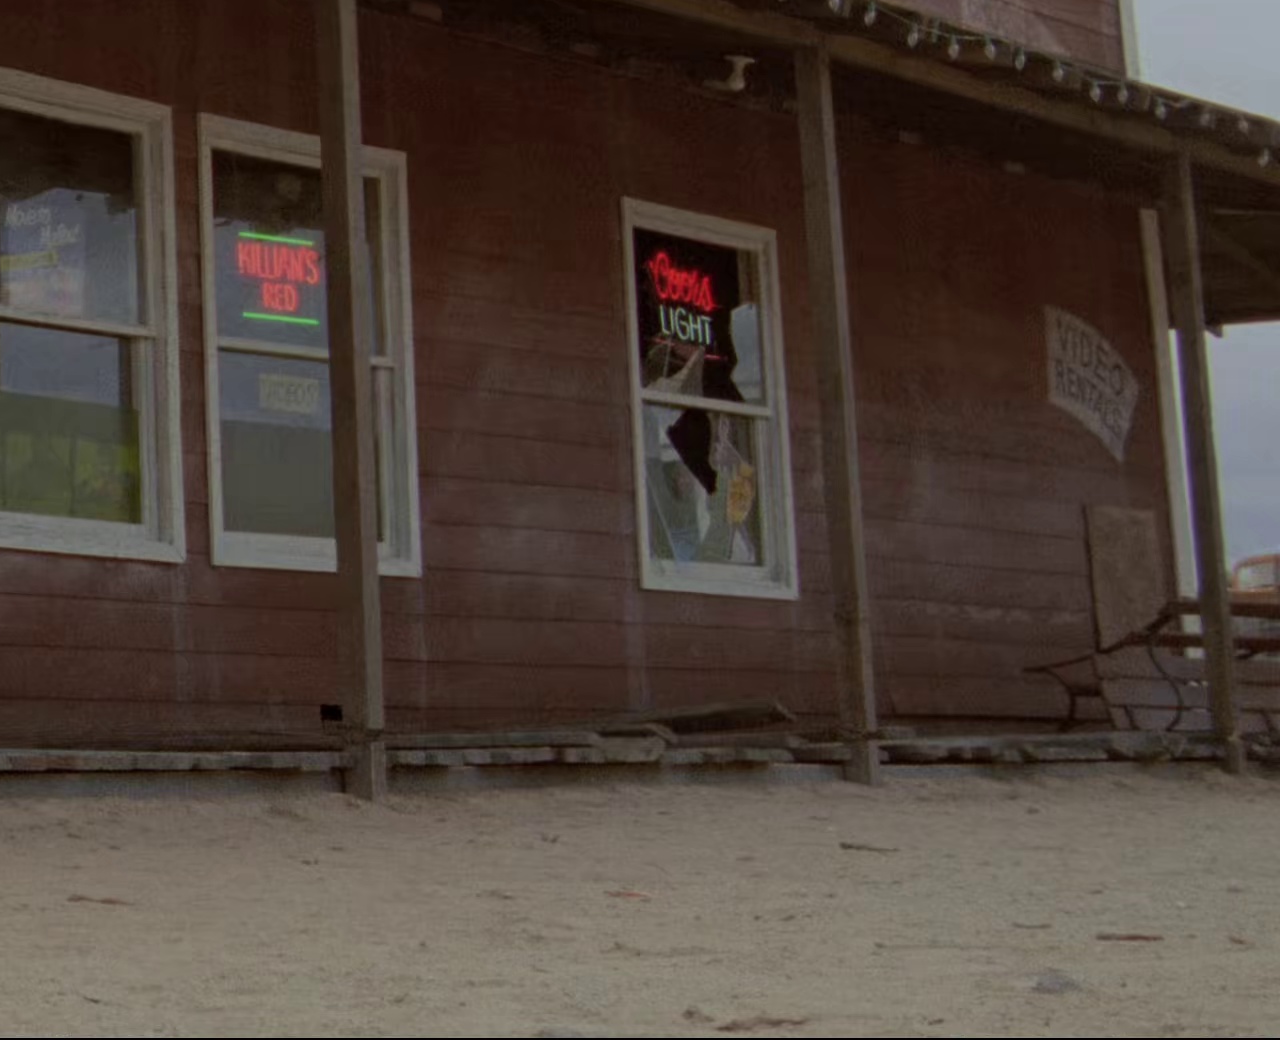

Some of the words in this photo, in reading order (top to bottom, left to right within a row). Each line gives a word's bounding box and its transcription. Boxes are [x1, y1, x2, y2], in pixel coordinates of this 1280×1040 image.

[261, 282, 300, 312] RED
[659, 303, 713, 346] LIGHT
[1055, 318, 1126, 396] VIDEO
